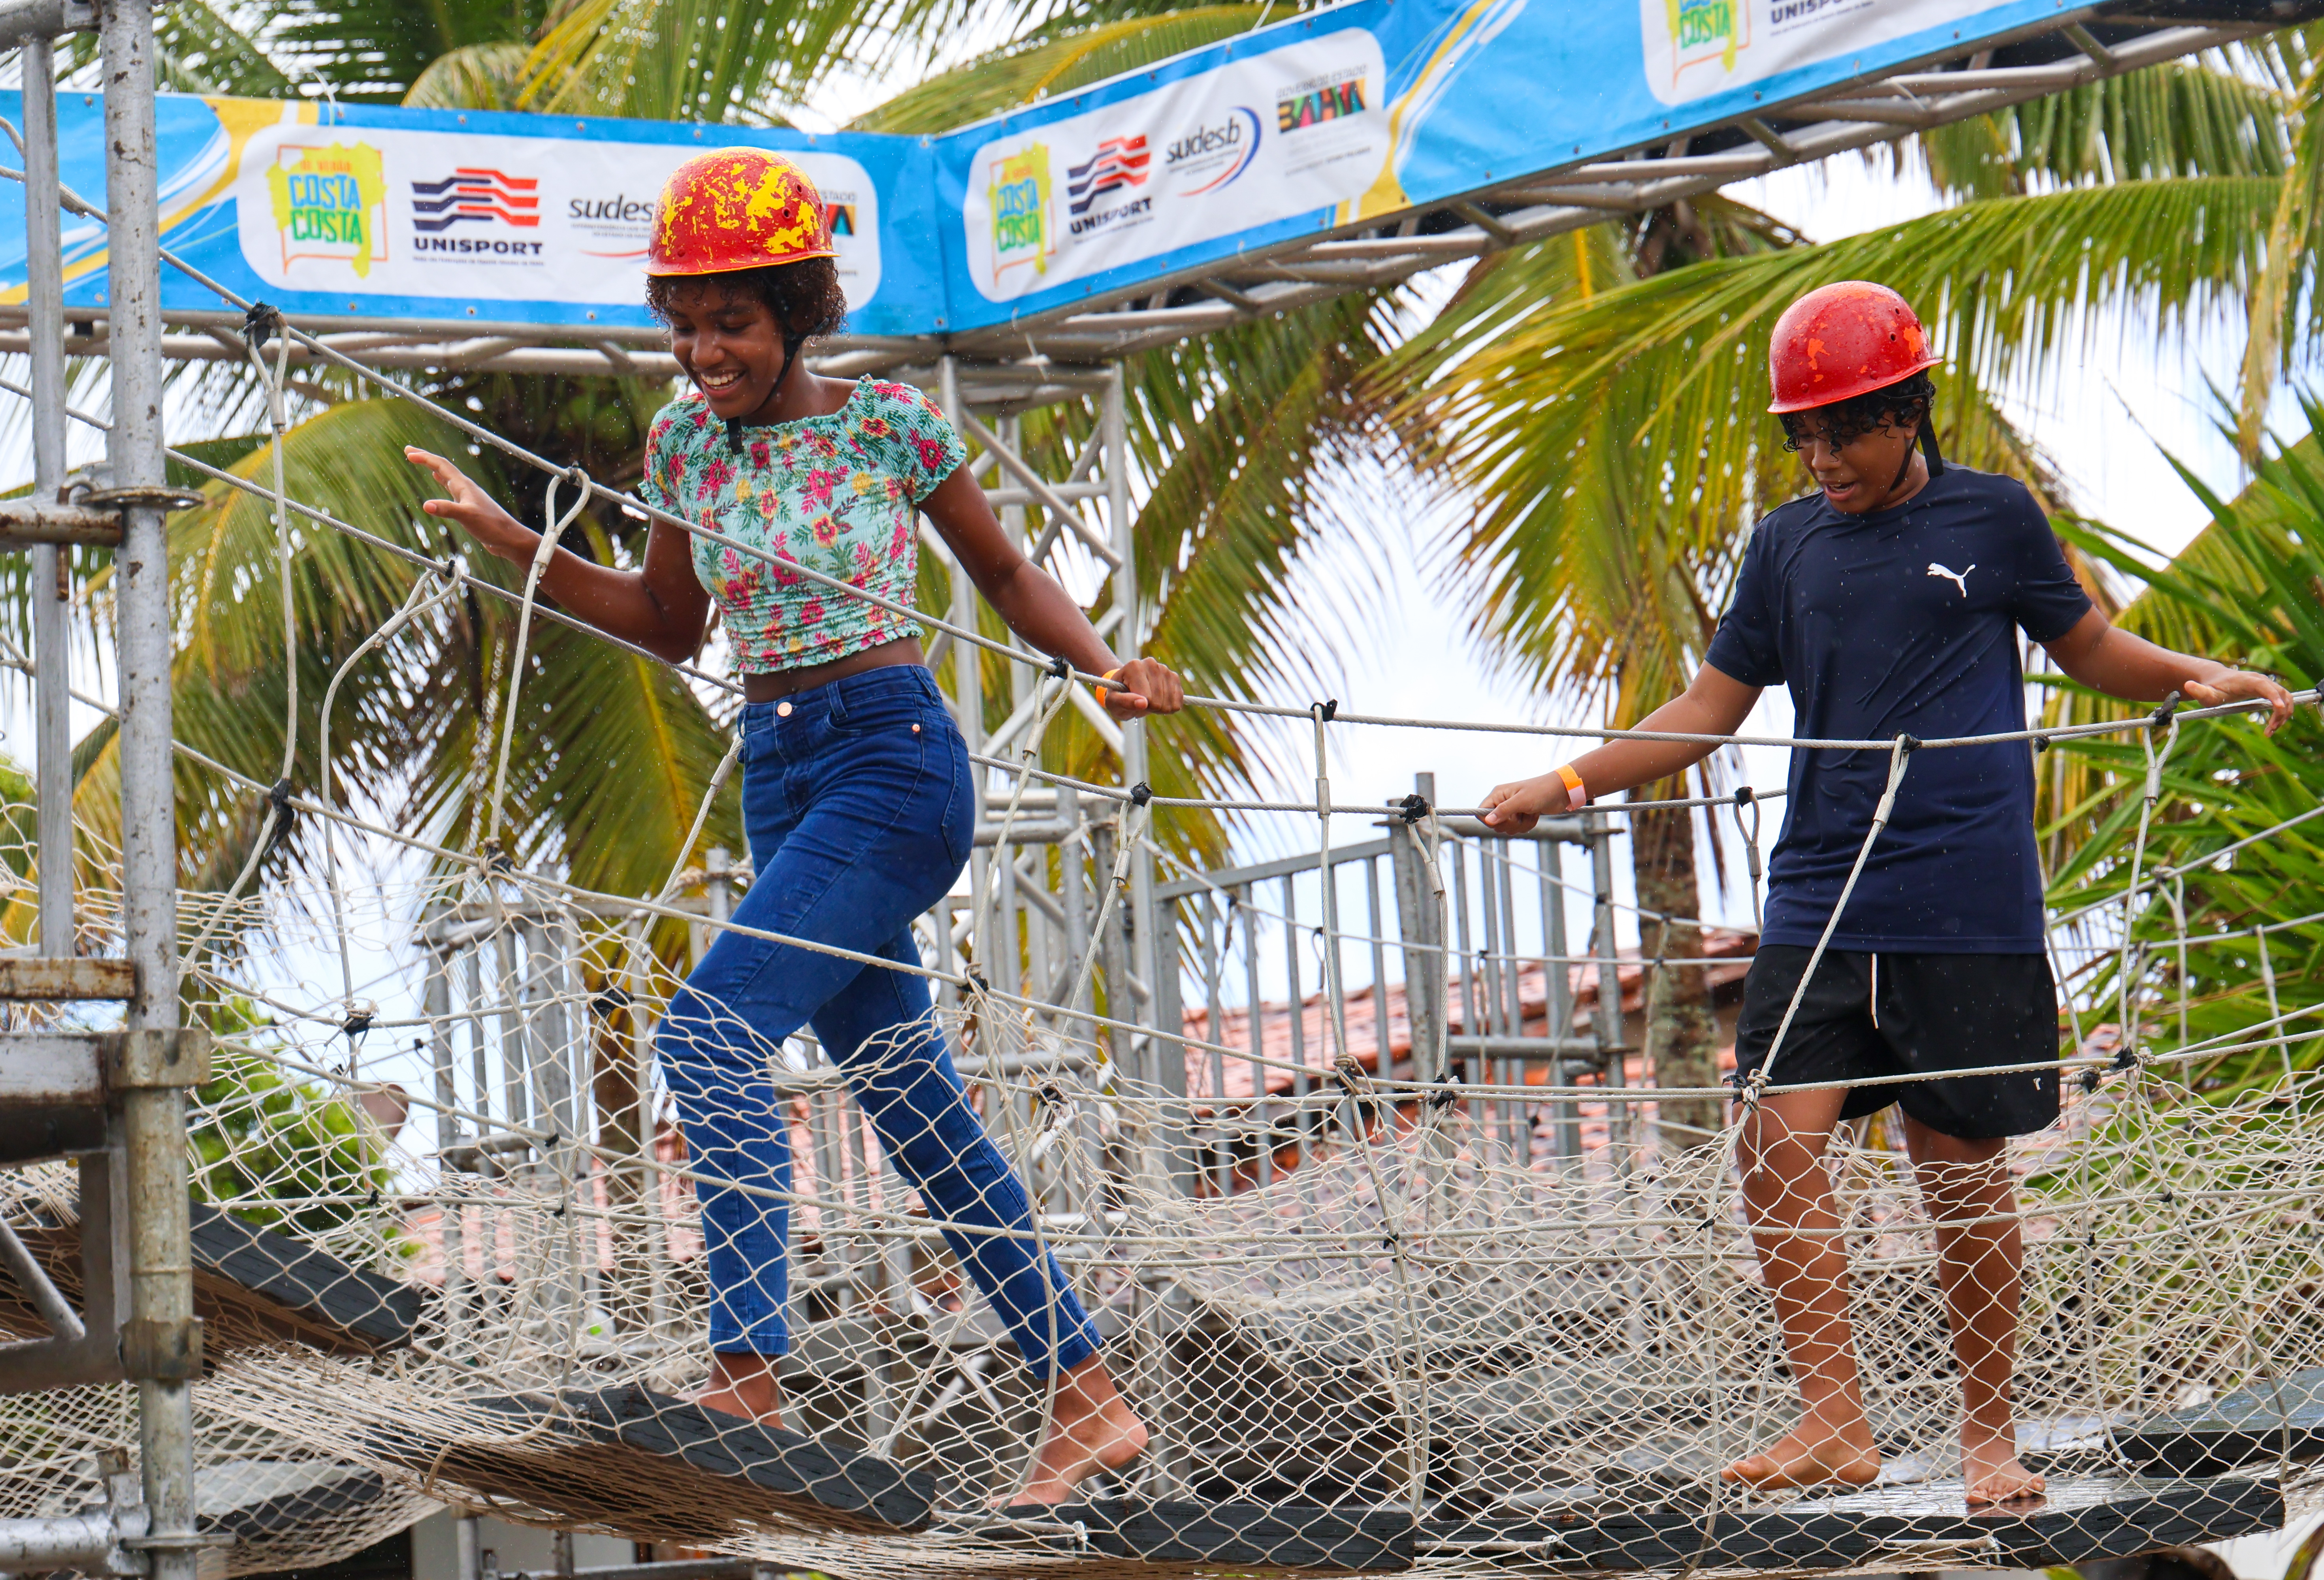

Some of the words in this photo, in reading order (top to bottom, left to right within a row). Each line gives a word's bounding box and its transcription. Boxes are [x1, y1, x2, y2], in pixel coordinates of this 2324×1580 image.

[1679, 2, 1730, 49] COSTA
[1772, 0, 1842, 23] UNISP
[1166, 117, 1240, 163] sudesb
[288, 174, 360, 209] COSTA
[568, 194, 654, 222] sudes
[998, 179, 1039, 220] COSTA
[291, 209, 362, 244] COSTA
[997, 213, 1040, 252] COSTA
[1071, 198, 1151, 233] UNISPORT
[415, 238, 542, 254] UNISPORT
